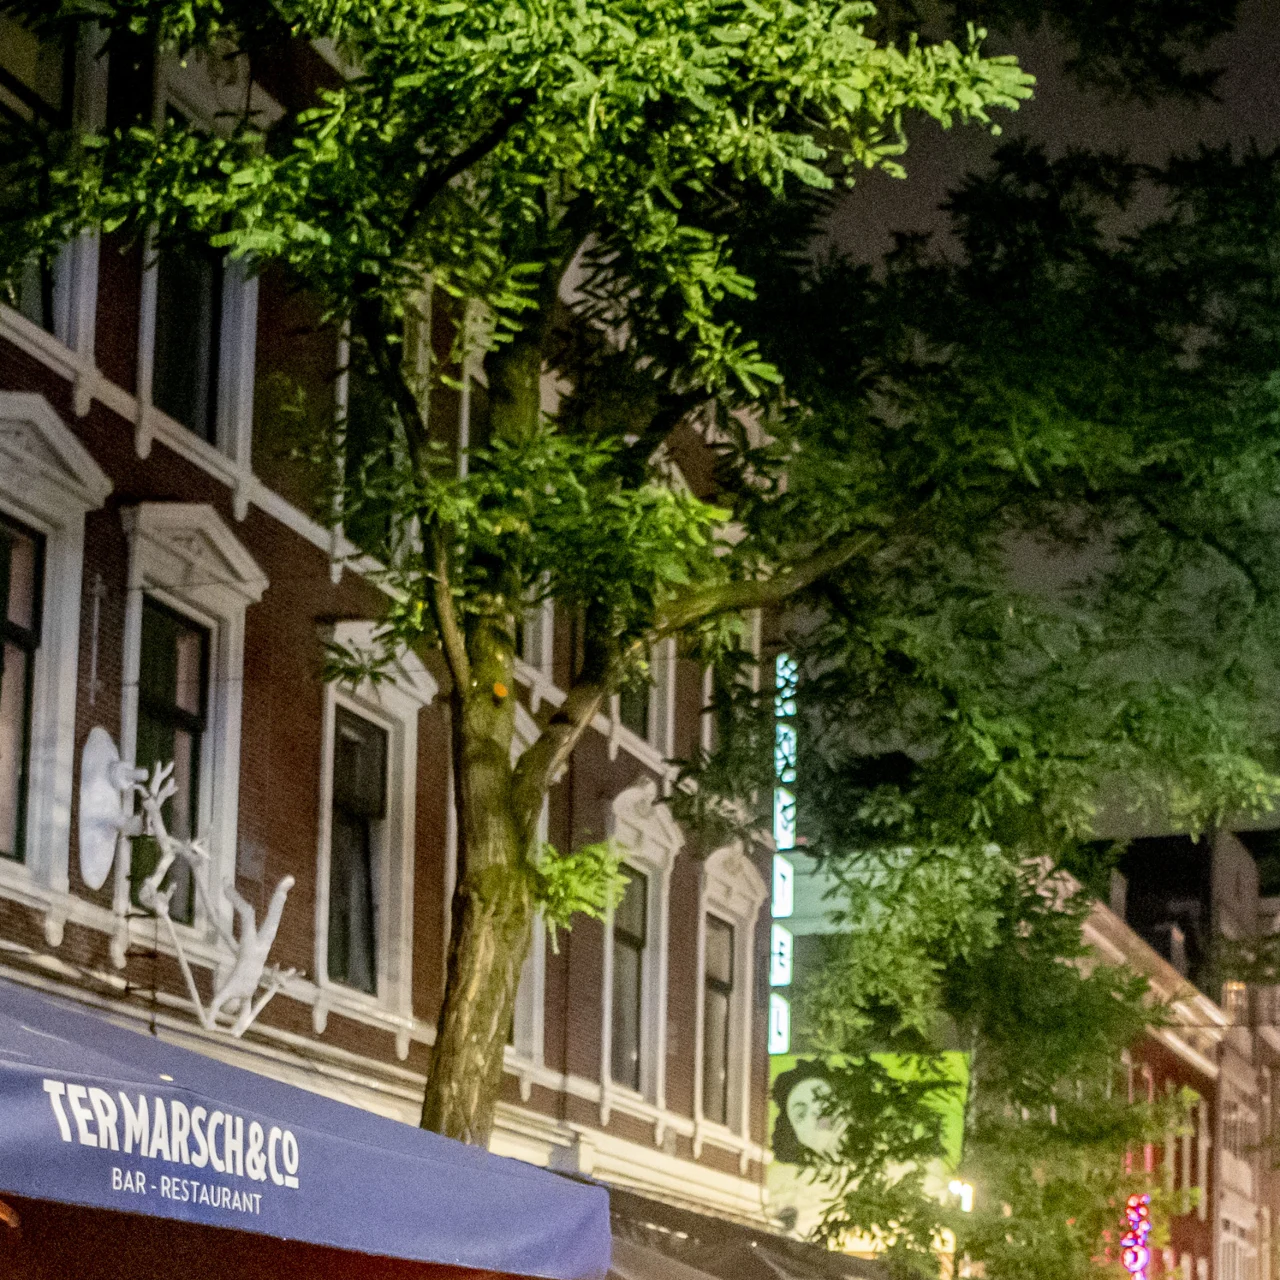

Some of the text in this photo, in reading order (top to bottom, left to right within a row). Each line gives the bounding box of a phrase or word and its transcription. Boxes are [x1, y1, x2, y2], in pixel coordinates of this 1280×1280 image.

[42, 1078, 120, 1152] TER
[111, 1166, 147, 1196] BAR
[159, 1174, 264, 1217] RESTAURANT
